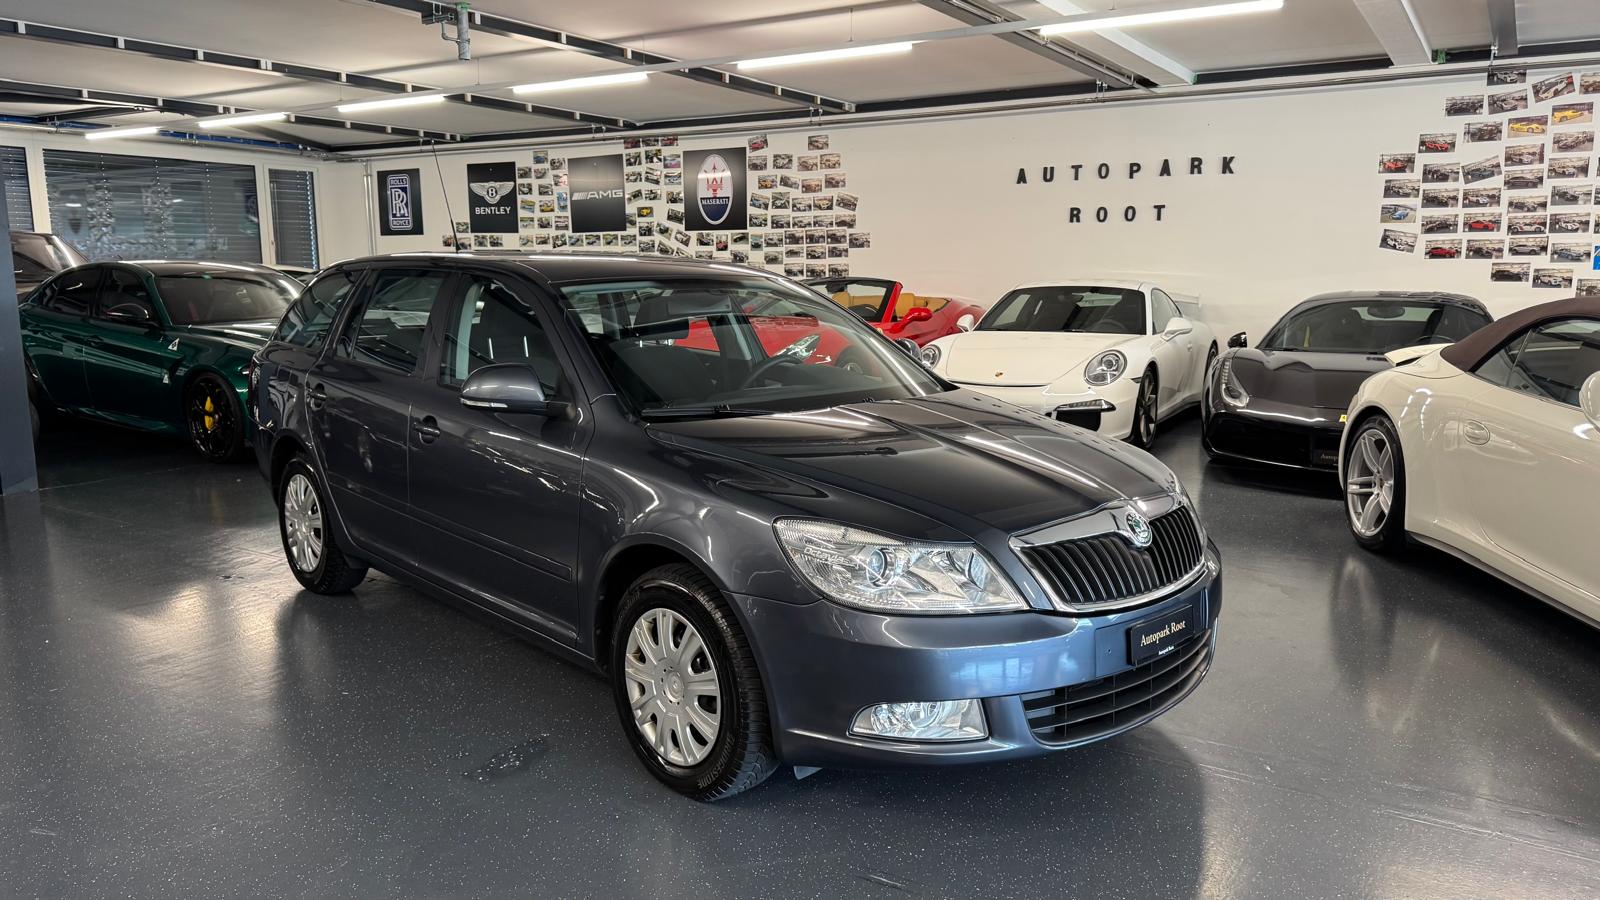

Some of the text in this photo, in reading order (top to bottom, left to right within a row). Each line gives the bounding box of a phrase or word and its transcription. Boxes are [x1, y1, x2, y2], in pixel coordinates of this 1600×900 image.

[1016, 156, 1236, 184] AUTOPARK
[475, 206, 511, 215] BENTLEY
[1069, 205, 1166, 223] ROOT
[1140, 620, 1186, 647] Autopark Root
